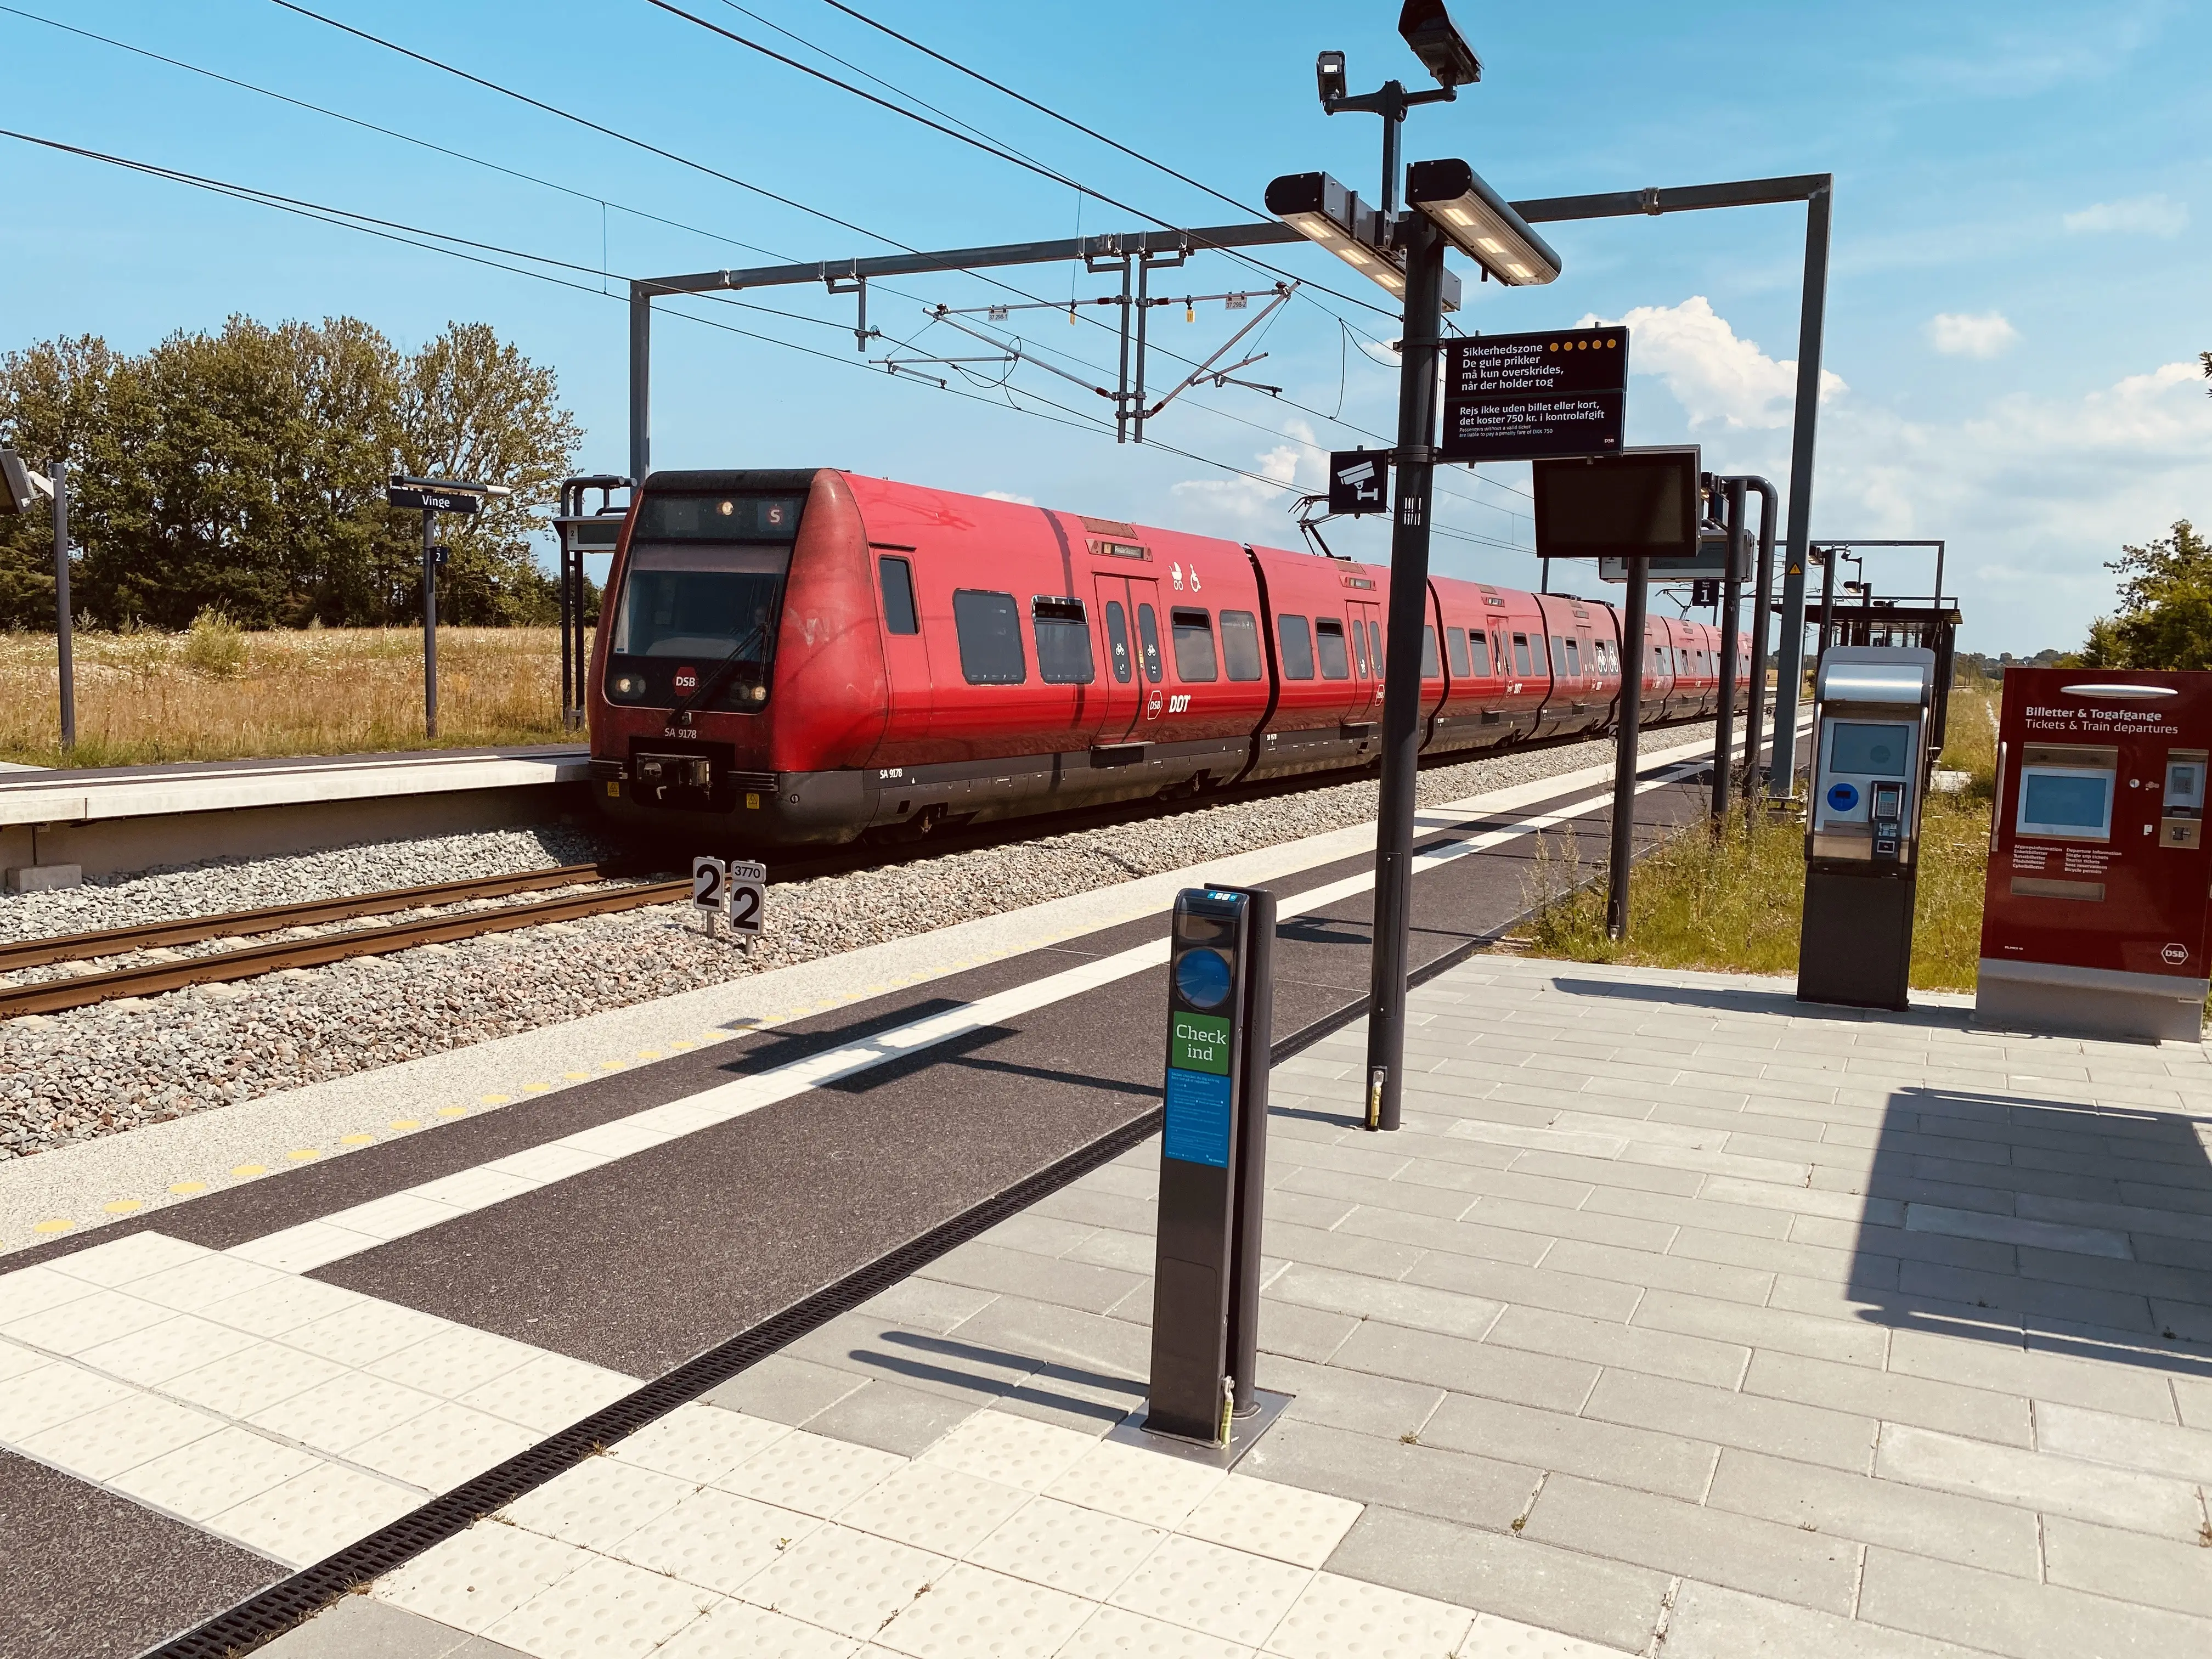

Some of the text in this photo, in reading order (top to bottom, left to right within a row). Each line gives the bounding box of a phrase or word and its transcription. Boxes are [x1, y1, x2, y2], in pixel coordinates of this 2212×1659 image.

[1463, 345, 1543, 357] Sikkerhedszone
[1463, 356, 1541, 369] De gule prikker
[1462, 365, 1564, 379] må kun overskrides,
[1462, 378, 1554, 391] når der holder tog
[1460, 400, 1600, 416] Rejs ikke uden billet eller kort,
[1459, 410, 1605, 425] det koster 750 kr. i kontrolafgift
[422, 495, 450, 509] Vinge
[770, 509, 781, 523] S
[436, 552, 441, 561] 2
[1701, 590, 1709, 602] 1
[675, 676, 696, 688] DSB
[1149, 700, 1161, 710] DSB
[1169, 695, 1190, 713] DOT
[2026, 707, 2162, 722] Billetter & Togafgange
[664, 727, 697, 740] SA 9178
[1609, 727, 1618, 740] 4
[2025, 719, 2179, 735] Tickets & Train departures
[879, 768, 902, 779] SA 9178
[734, 866, 760, 878] 3770
[696, 864, 720, 907] 2
[733, 887, 760, 930] 2
[2165, 950, 2185, 958] DSB
[1176, 1024, 1226, 1045] Check
[1187, 1043, 1213, 1061] ind
